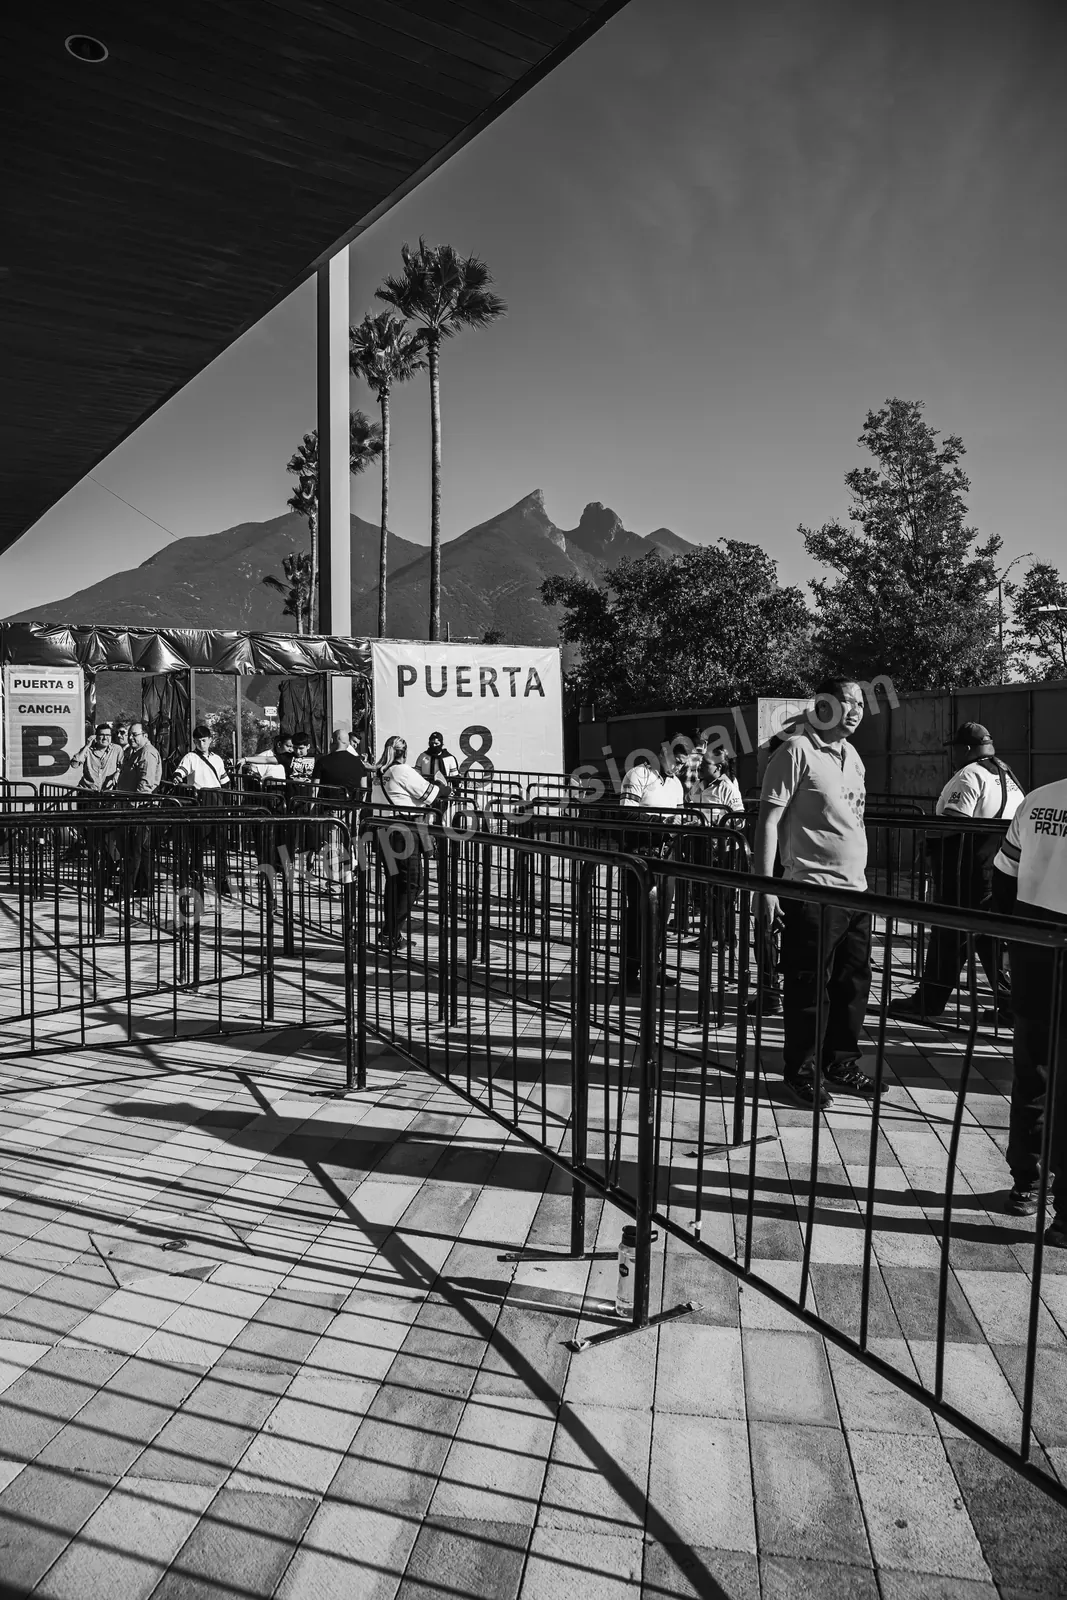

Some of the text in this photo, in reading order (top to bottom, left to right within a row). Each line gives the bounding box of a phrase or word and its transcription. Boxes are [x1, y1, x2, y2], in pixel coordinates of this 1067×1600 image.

[14, 679, 74, 689] PUERTA 8
[397, 664, 546, 698] PUERTA
[18, 704, 71, 714] CANCHA
[21, 725, 71, 778] B
[458, 724, 495, 789] 8
